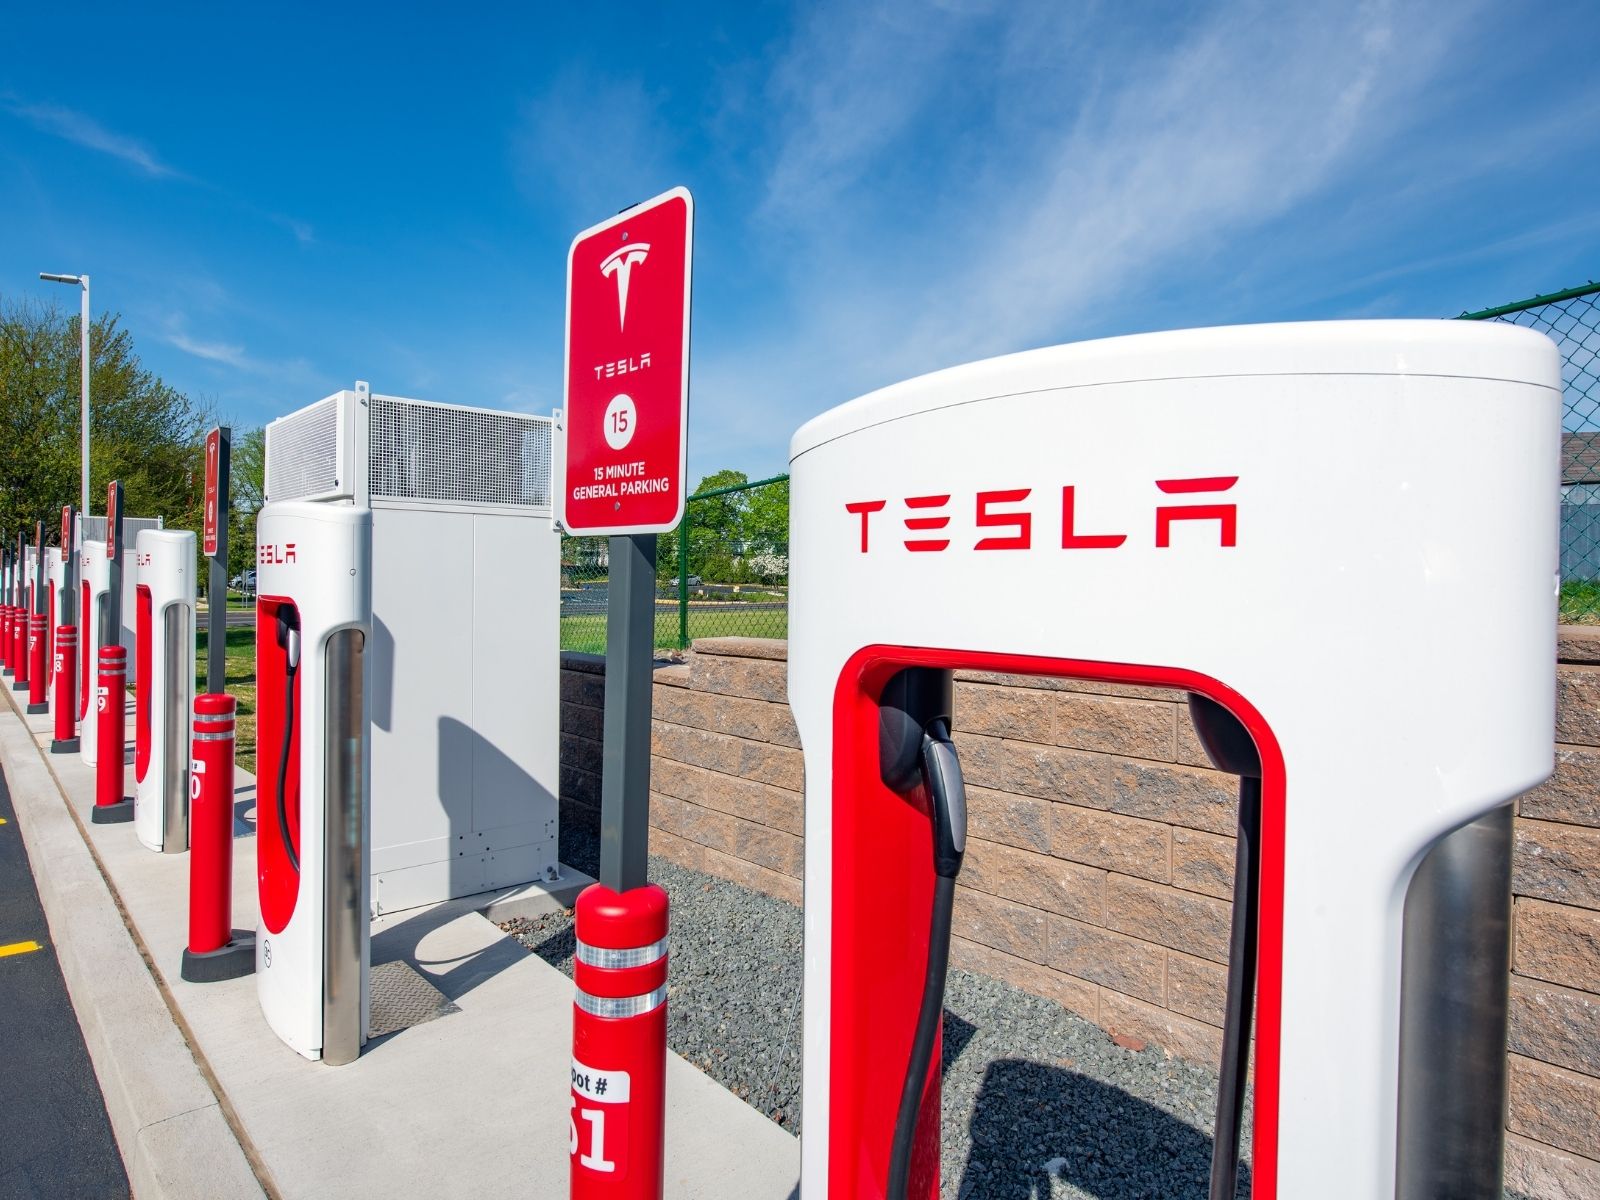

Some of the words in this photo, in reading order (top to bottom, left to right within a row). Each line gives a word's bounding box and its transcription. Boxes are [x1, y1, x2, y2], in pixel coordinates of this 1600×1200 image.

[594, 352, 651, 380] TESLA
[611, 410, 628, 433] 15
[593, 467, 604, 481] 15
[605, 462, 645, 479] MINUTE
[573, 484, 618, 500] GENERAL
[620, 477, 669, 496] PARKING
[845, 476, 1239, 553] TESLA
[260, 543, 296, 564] ESLA
[98, 696, 106, 712] 9
[191, 774, 201, 800] 0
[571, 1068, 590, 1092] pot
[595, 1077, 607, 1096] #
